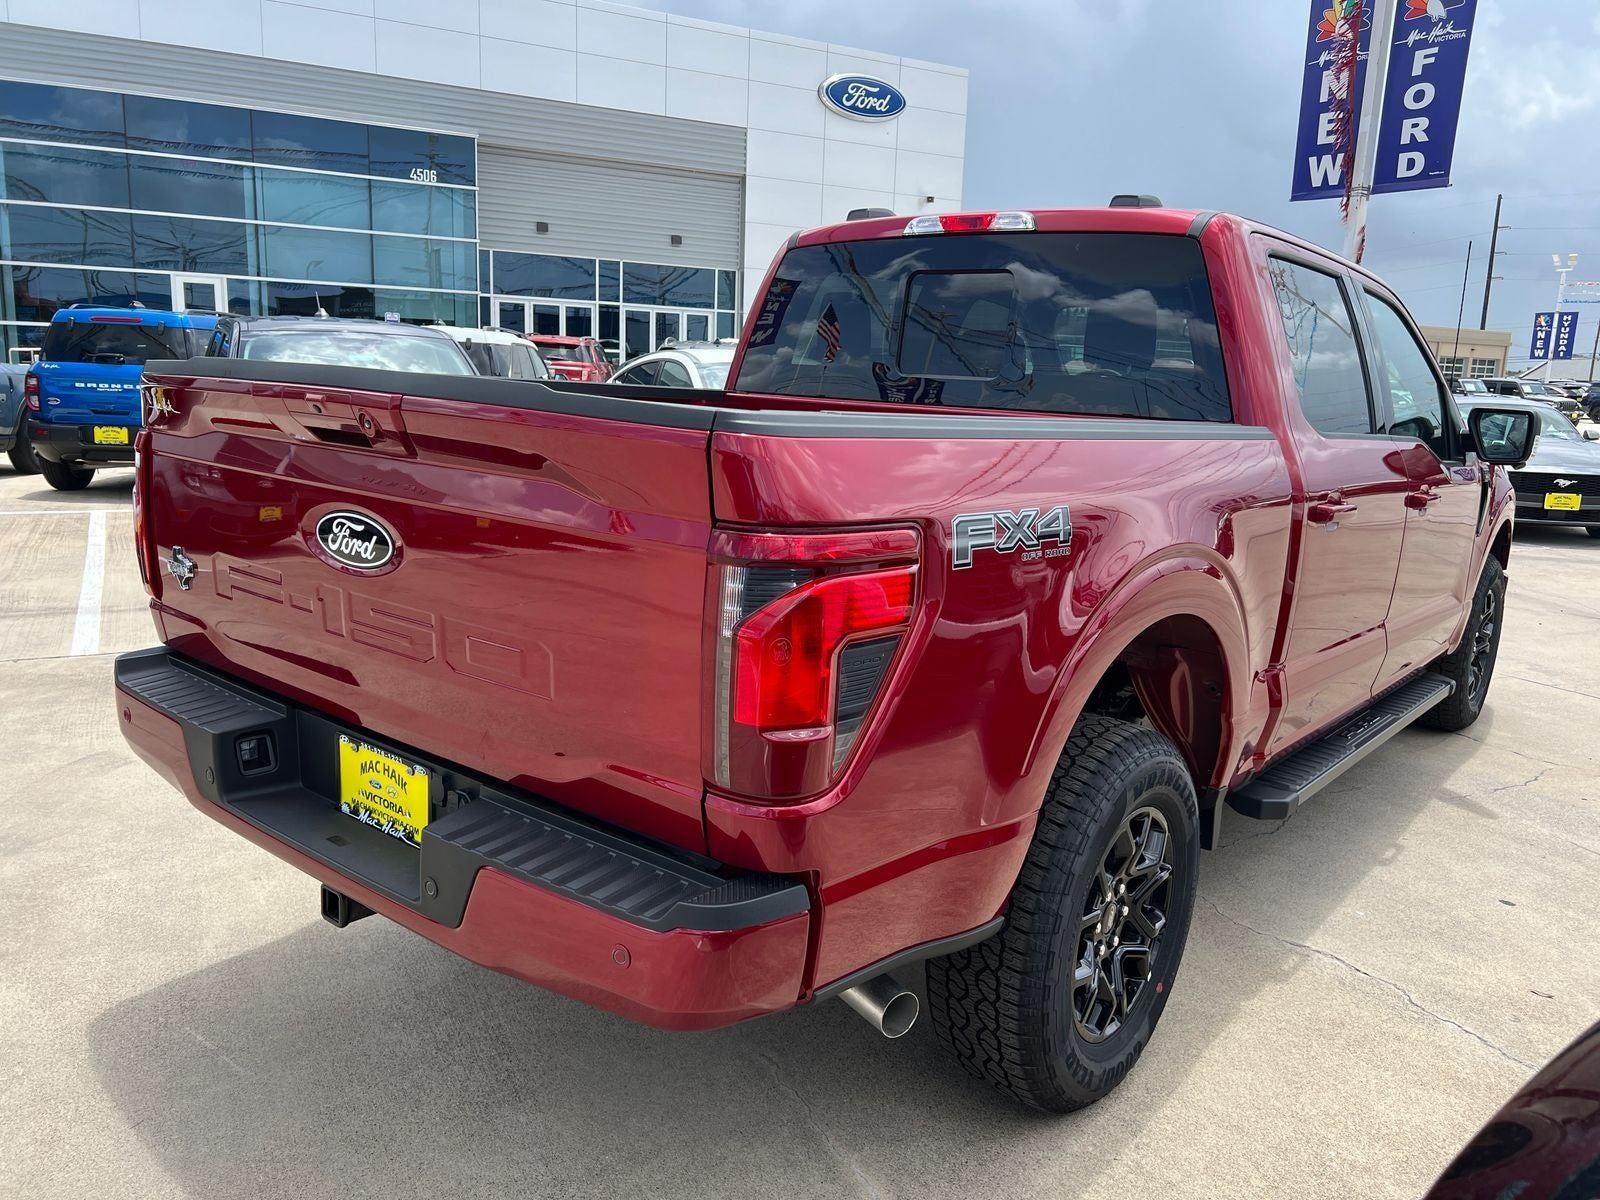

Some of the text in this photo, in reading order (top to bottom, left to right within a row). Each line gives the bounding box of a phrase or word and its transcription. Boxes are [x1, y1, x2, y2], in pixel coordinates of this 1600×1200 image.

[1434, 32, 1467, 43] VICTORIA
[842, 83, 891, 112] Ford
[1396, 46, 1440, 179] FORD
[410, 168, 437, 183] 4506
[1534, 331, 1545, 357] NEW
[1558, 314, 1572, 357] HYUNDAI
[328, 518, 378, 560] Ford
[951, 505, 1072, 571] FX4
[1021, 547, 1071, 561] OFF ROAD
[210, 551, 553, 701] F-150
[360, 760, 381, 776] MAC
[383, 762, 408, 795] HAIK
[364, 789, 405, 816] VICTORIA
[350, 808, 415, 845] Mac Haik
